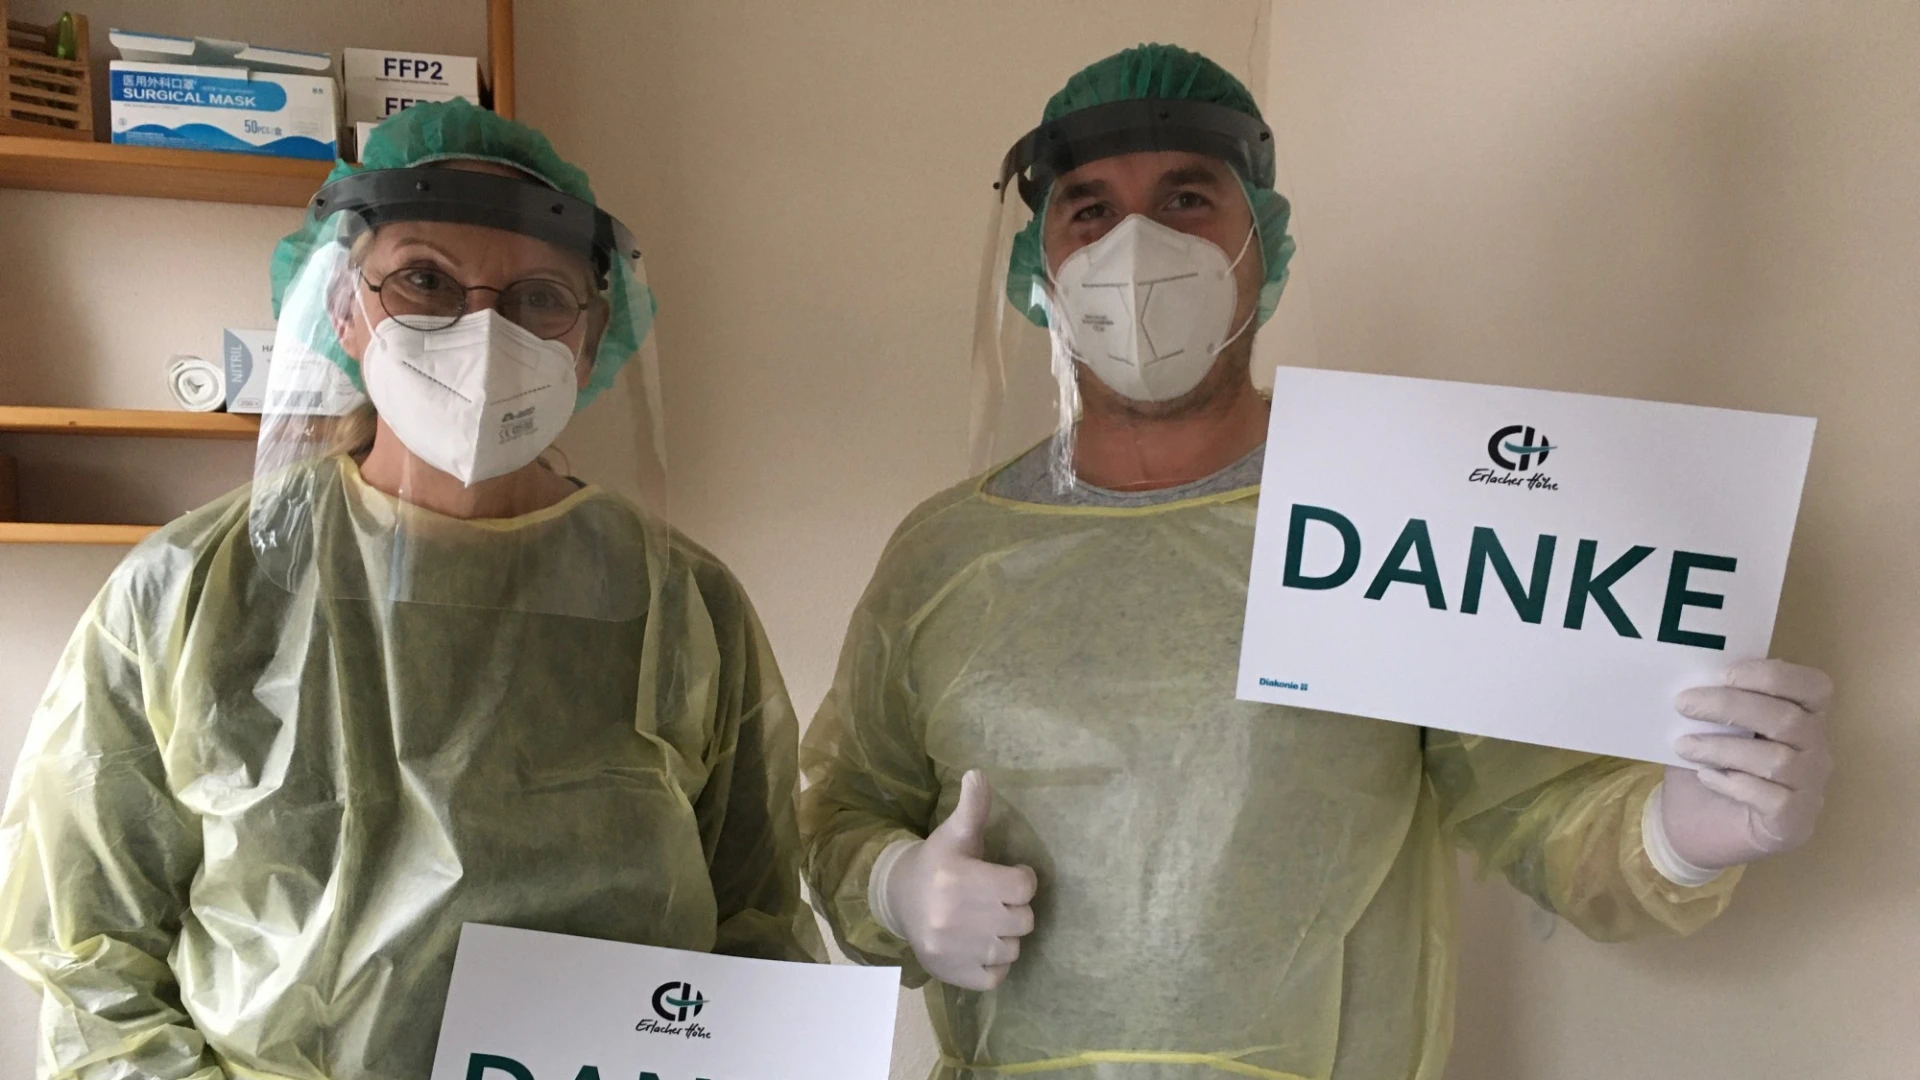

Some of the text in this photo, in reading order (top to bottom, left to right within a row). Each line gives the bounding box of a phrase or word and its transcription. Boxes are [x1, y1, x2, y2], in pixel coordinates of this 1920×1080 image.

[383, 57, 443, 81] FFP2
[122, 74, 195, 90] 医用外科口罩
[122, 87, 205, 104] SURGICAL
[208, 93, 257, 107] MASK
[230, 344, 243, 383] NITRIL
[1468, 467, 1559, 491] Erlacher Höhe
[1282, 502, 1738, 651] DANKE
[1259, 677, 1299, 690] Diakonie
[635, 1018, 712, 1040] Erlacher Höhe
